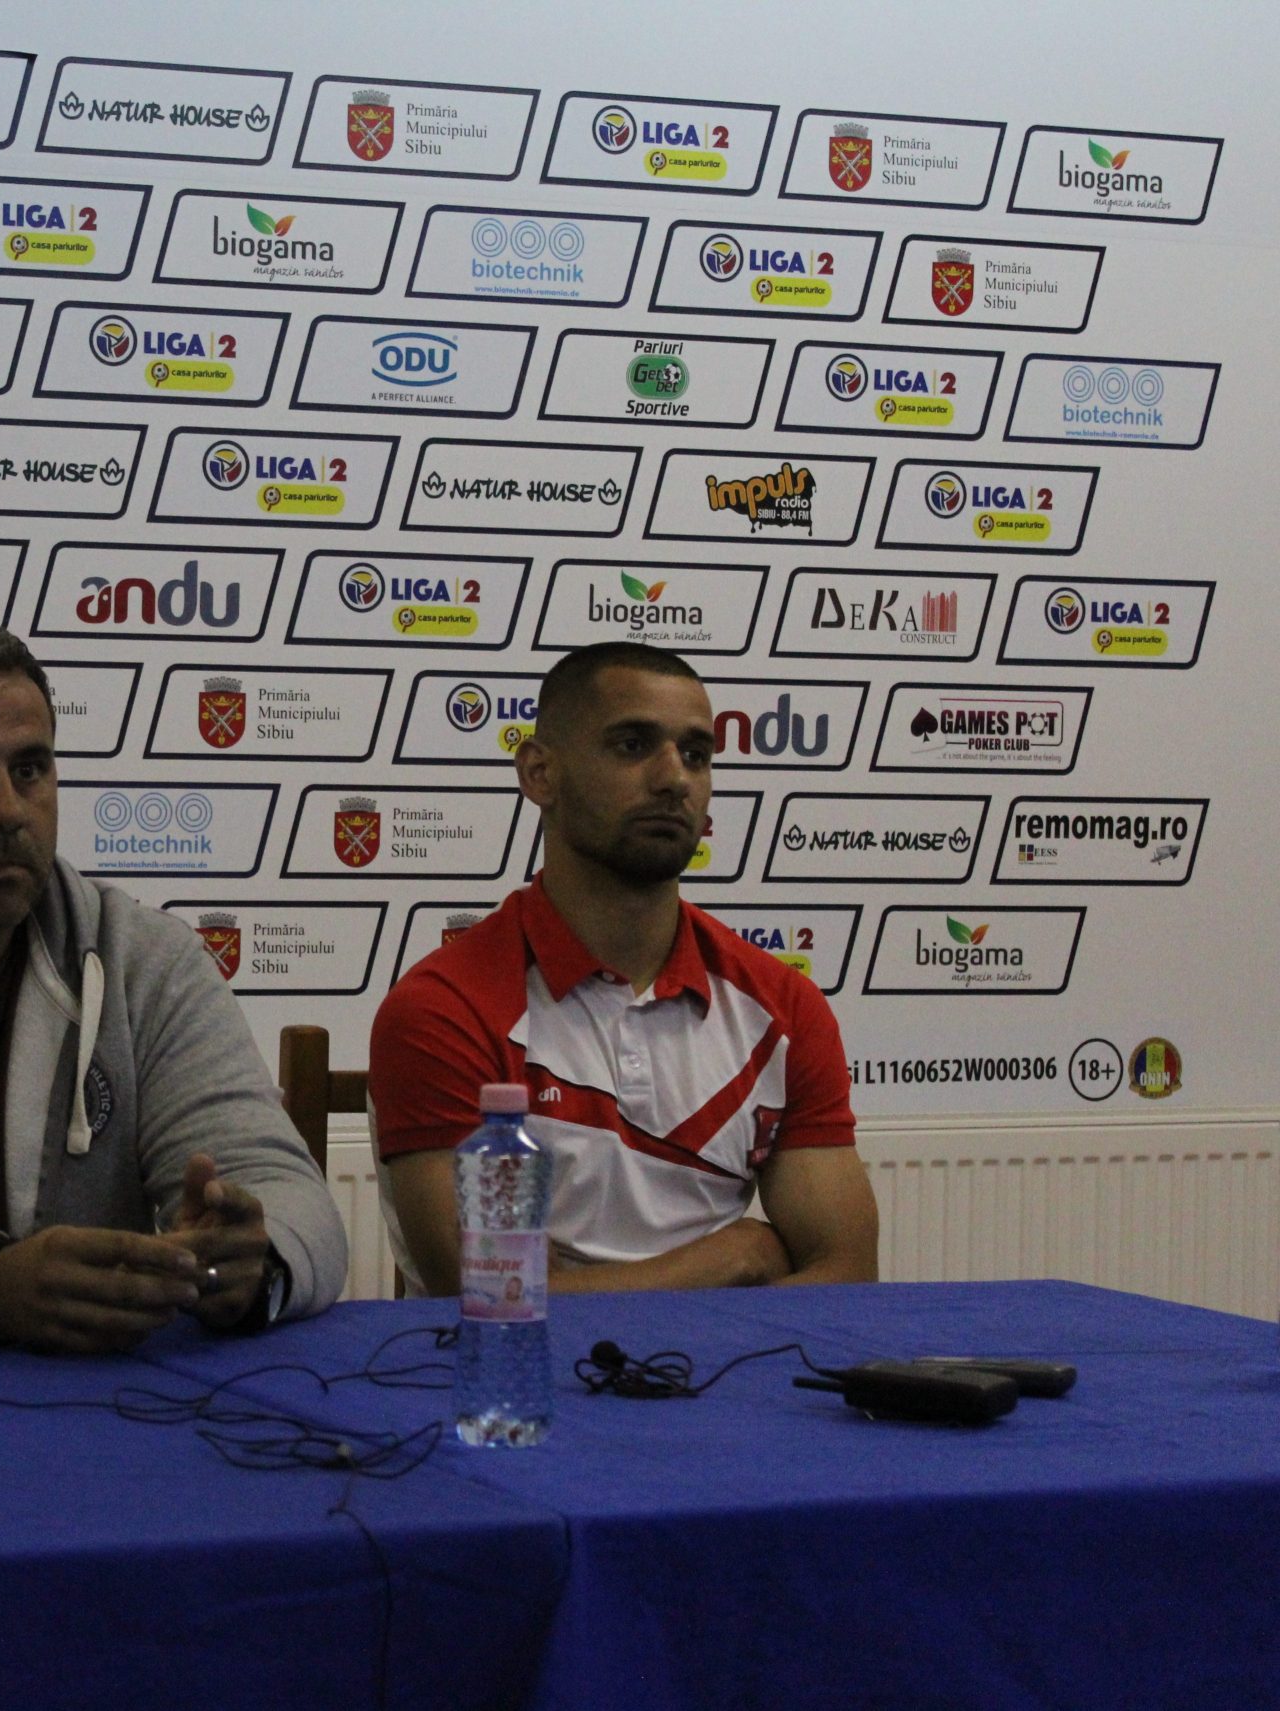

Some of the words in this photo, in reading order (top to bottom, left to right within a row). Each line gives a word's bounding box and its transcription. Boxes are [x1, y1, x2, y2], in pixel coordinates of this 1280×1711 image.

[88, 100, 164, 123] NATUR
[169, 104, 243, 128] HOUSE
[643, 122, 700, 146] LIGA
[713, 126, 729, 148] 2
[884, 152, 958, 171] Municipiului
[882, 170, 916, 185] Sibiu
[1059, 150, 1163, 197] biogama
[214, 215, 334, 265] biogama
[472, 259, 584, 283] biotechnik
[750, 249, 805, 273] LIGA
[818, 252, 833, 275] 2
[985, 277, 1058, 295] Municipiului
[984, 295, 1016, 310] Sibiu
[144, 331, 205, 356] LIGA
[219, 335, 236, 358] 2
[634, 340, 683, 354] Pariuri
[379, 346, 450, 374] ODU
[874, 369, 928, 393] LIGA
[940, 372, 956, 394] 2
[626, 400, 689, 416] Sportive
[1063, 403, 1163, 426] biotechnik
[23, 460, 97, 483] HOUSE
[450, 479, 522, 500] NATUR
[527, 481, 596, 503] HOUSE
[707, 462, 810, 517] impuls
[972, 486, 1025, 509] LIGA
[1037, 488, 1052, 510] 2
[757, 509, 776, 518] SIBIU
[799, 511, 809, 520] FM
[775, 497, 810, 510] radio
[76, 561, 239, 627] andu
[391, 578, 450, 602] LIGA
[463, 580, 480, 603] 2
[589, 584, 703, 630] biogama
[1091, 602, 1143, 623] LIGA
[1155, 603, 1169, 624] 2
[900, 634, 956, 644] CONSTRUCT
[498, 698, 539, 721] LIG
[715, 693, 828, 756] ndu
[941, 710, 1009, 735] GAMES
[968, 737, 1001, 750] POKER
[1004, 739, 1030, 751] CLUB
[393, 825, 472, 842] Municipiului
[809, 830, 877, 850] NATUR
[882, 831, 947, 851] HOUSE
[1015, 815, 1187, 848] remomag.ro
[95, 834, 212, 853] biotechnik
[391, 844, 427, 858] Sibiu
[253, 941, 334, 957] Municipiului
[733, 928, 785, 949] IGA
[797, 928, 813, 950] 2
[916, 928, 1023, 973] biogama
[252, 959, 288, 973] Sibiu
[866, 1057, 1057, 1084] L1160652W000306
[1079, 1059, 1115, 1080] 18+
